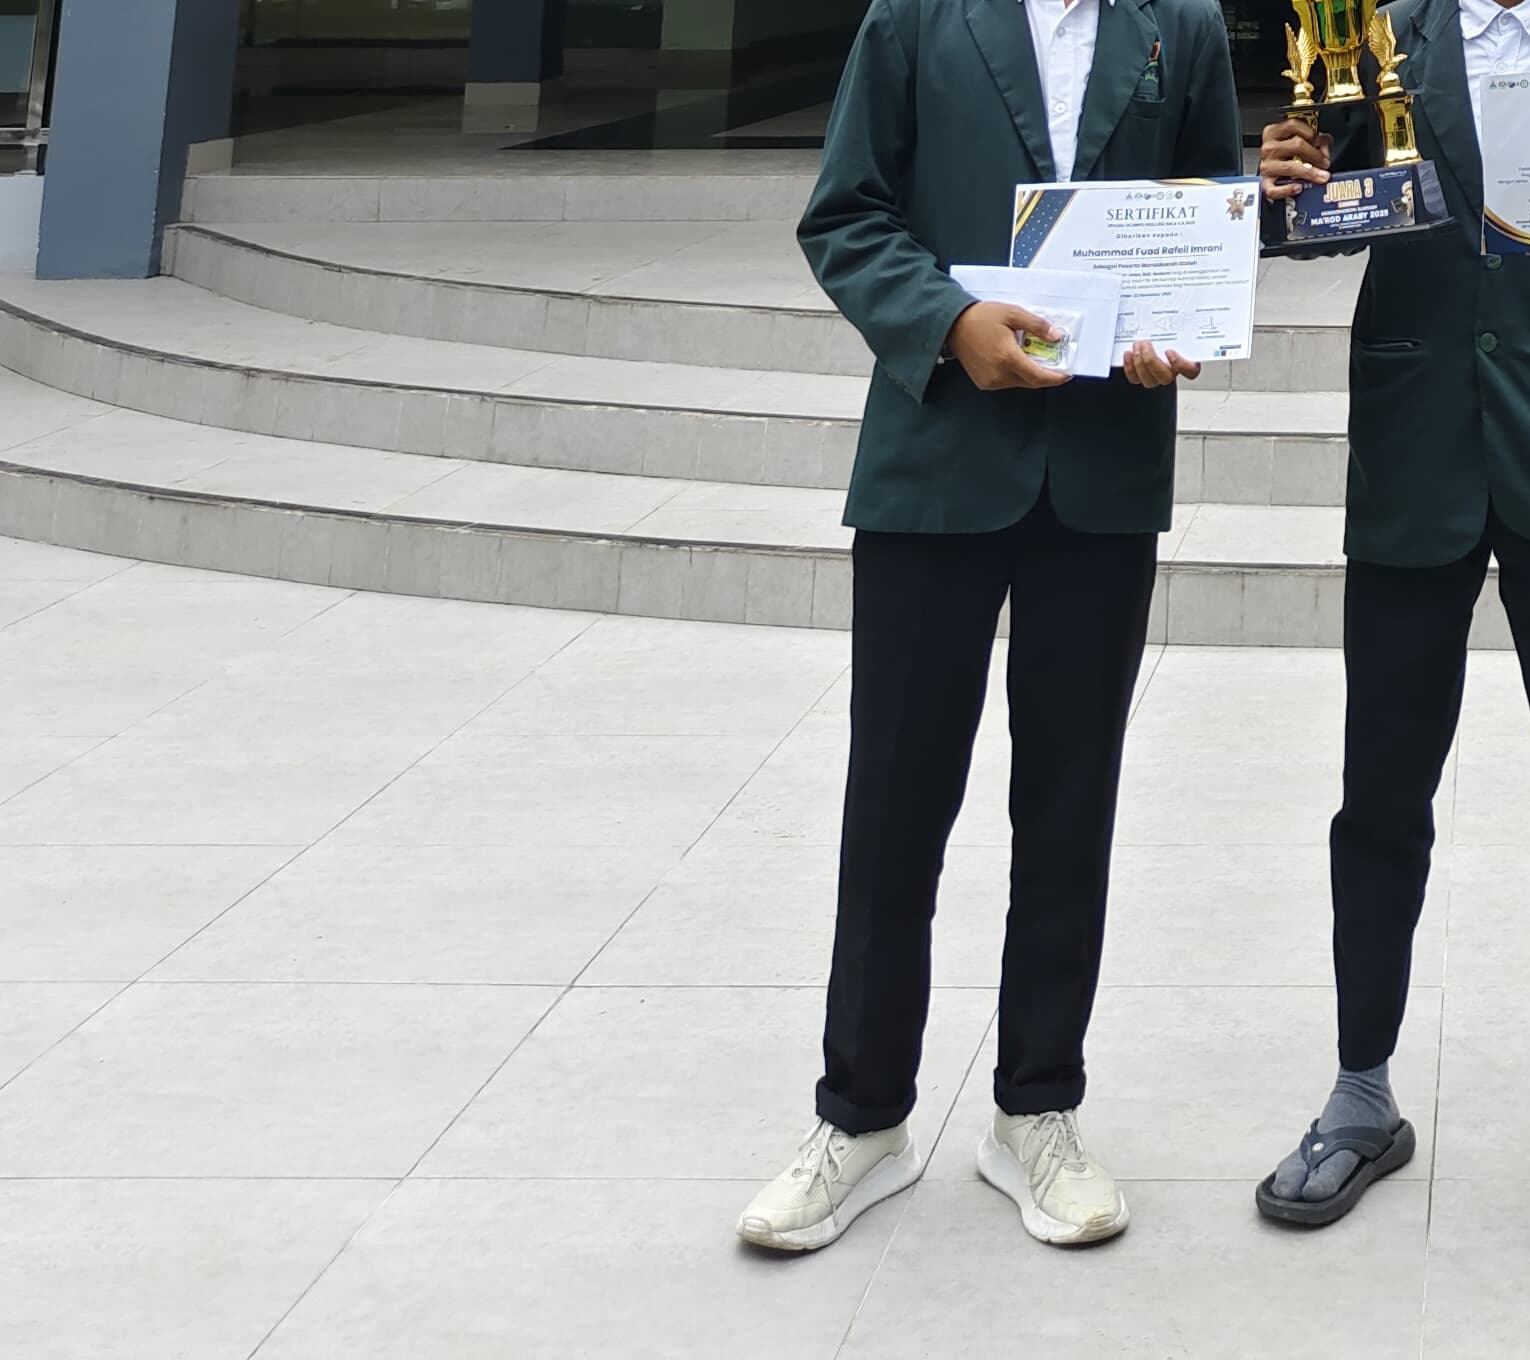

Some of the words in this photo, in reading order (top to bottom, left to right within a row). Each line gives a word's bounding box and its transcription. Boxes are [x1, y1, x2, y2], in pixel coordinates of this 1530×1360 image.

[1323, 179, 1362, 202] JUARA
[1363, 177, 1374, 198] 3
[1106, 205, 1199, 221] SERTIFIKAT
[1342, 211, 1369, 222] ARABY
[1369, 208, 1389, 219] 2025
[1072, 247, 1134, 258] Muhammad
[1135, 246, 1160, 256] Fuad
[1190, 242, 1223, 254] Imrani
